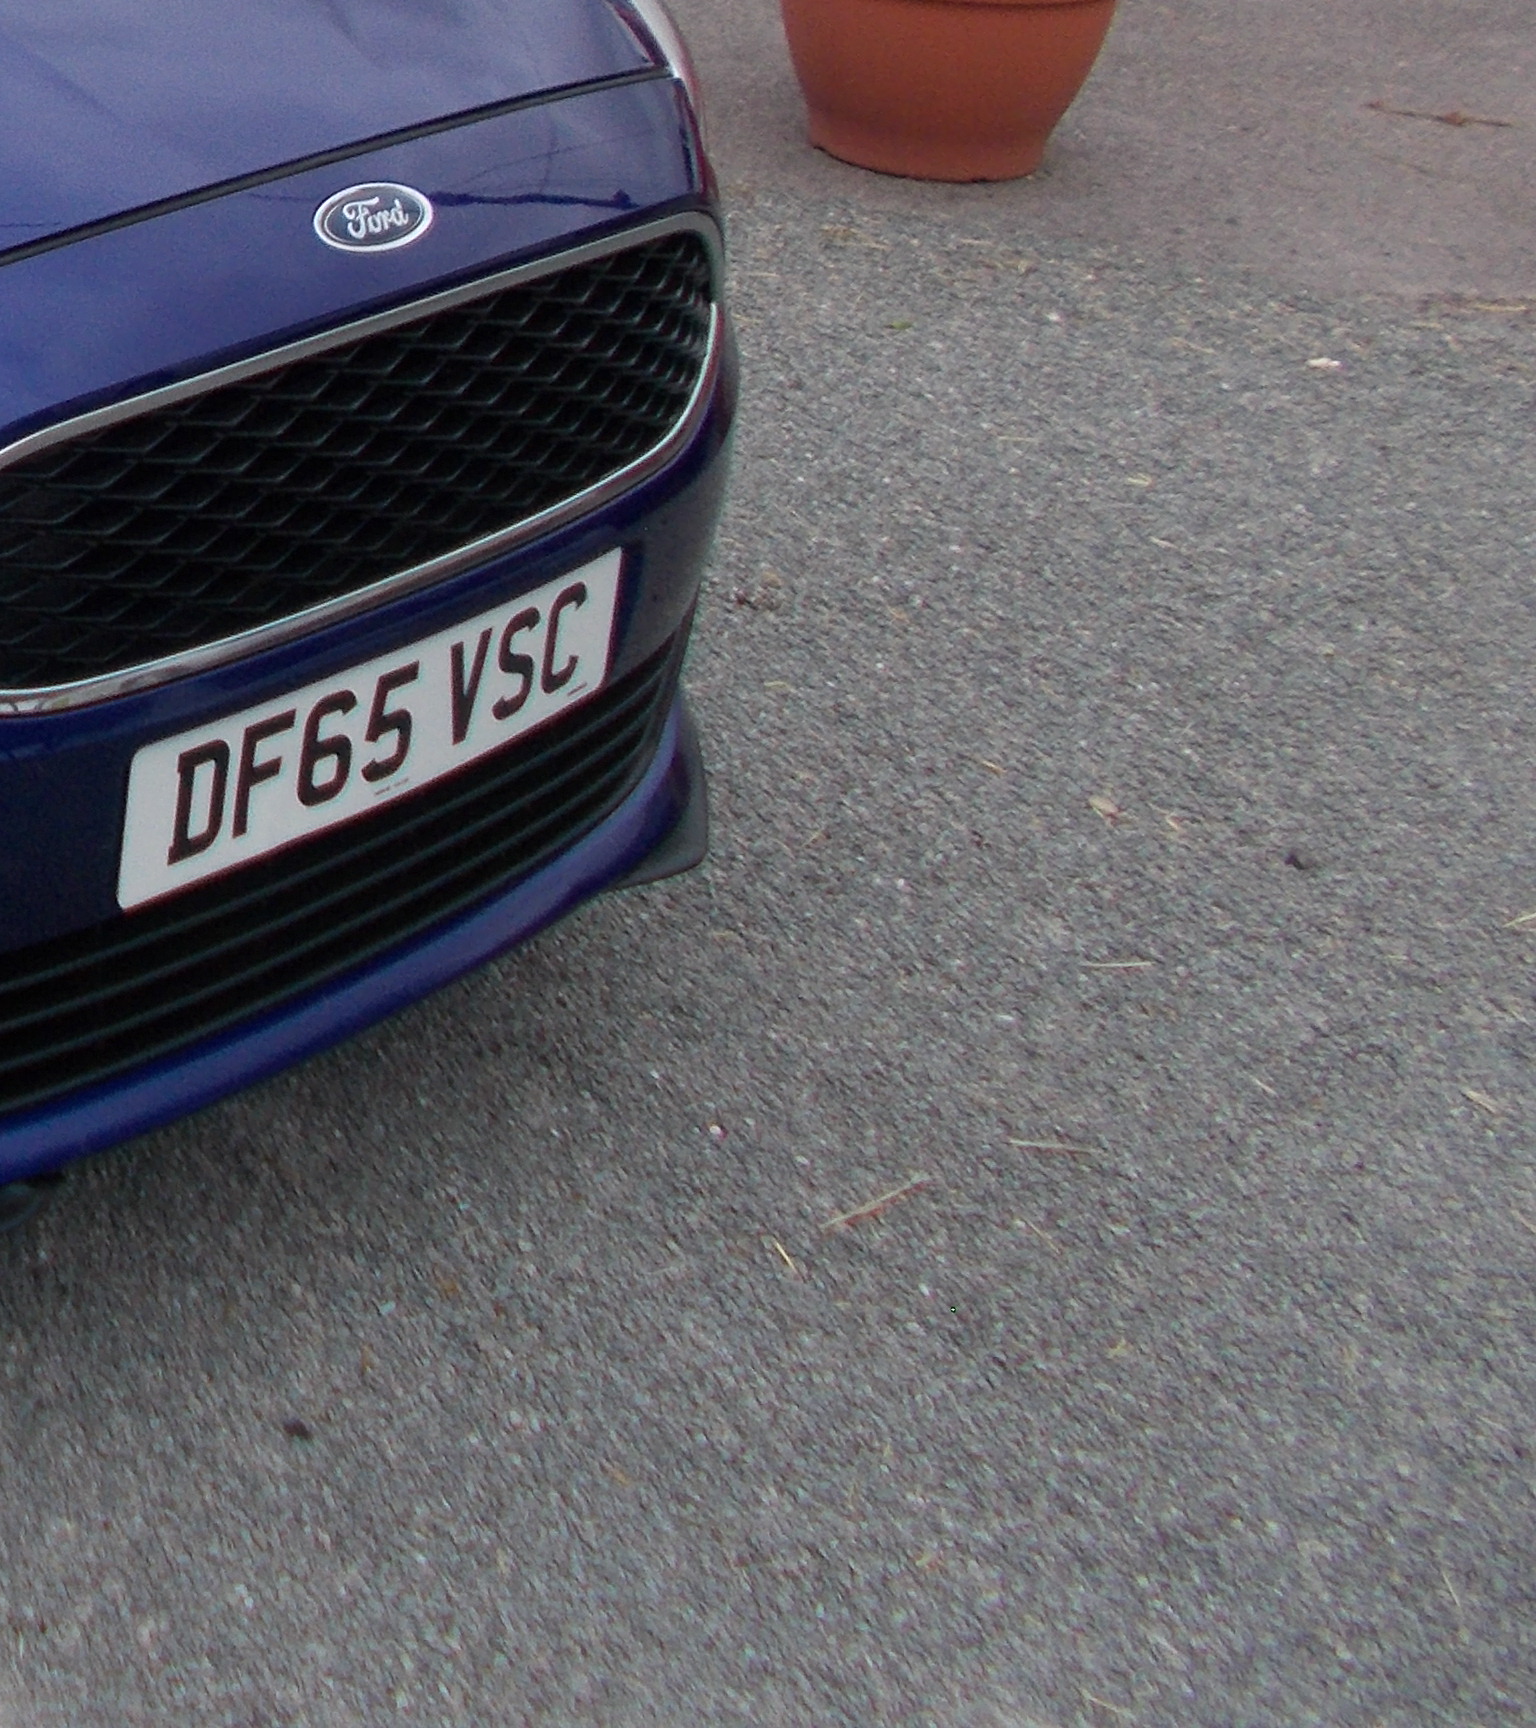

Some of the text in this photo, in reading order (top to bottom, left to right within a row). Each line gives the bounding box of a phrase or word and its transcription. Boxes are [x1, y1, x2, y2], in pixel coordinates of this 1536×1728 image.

[342, 196, 409, 240] Ford
[166, 579, 589, 866] DF65 VSC
